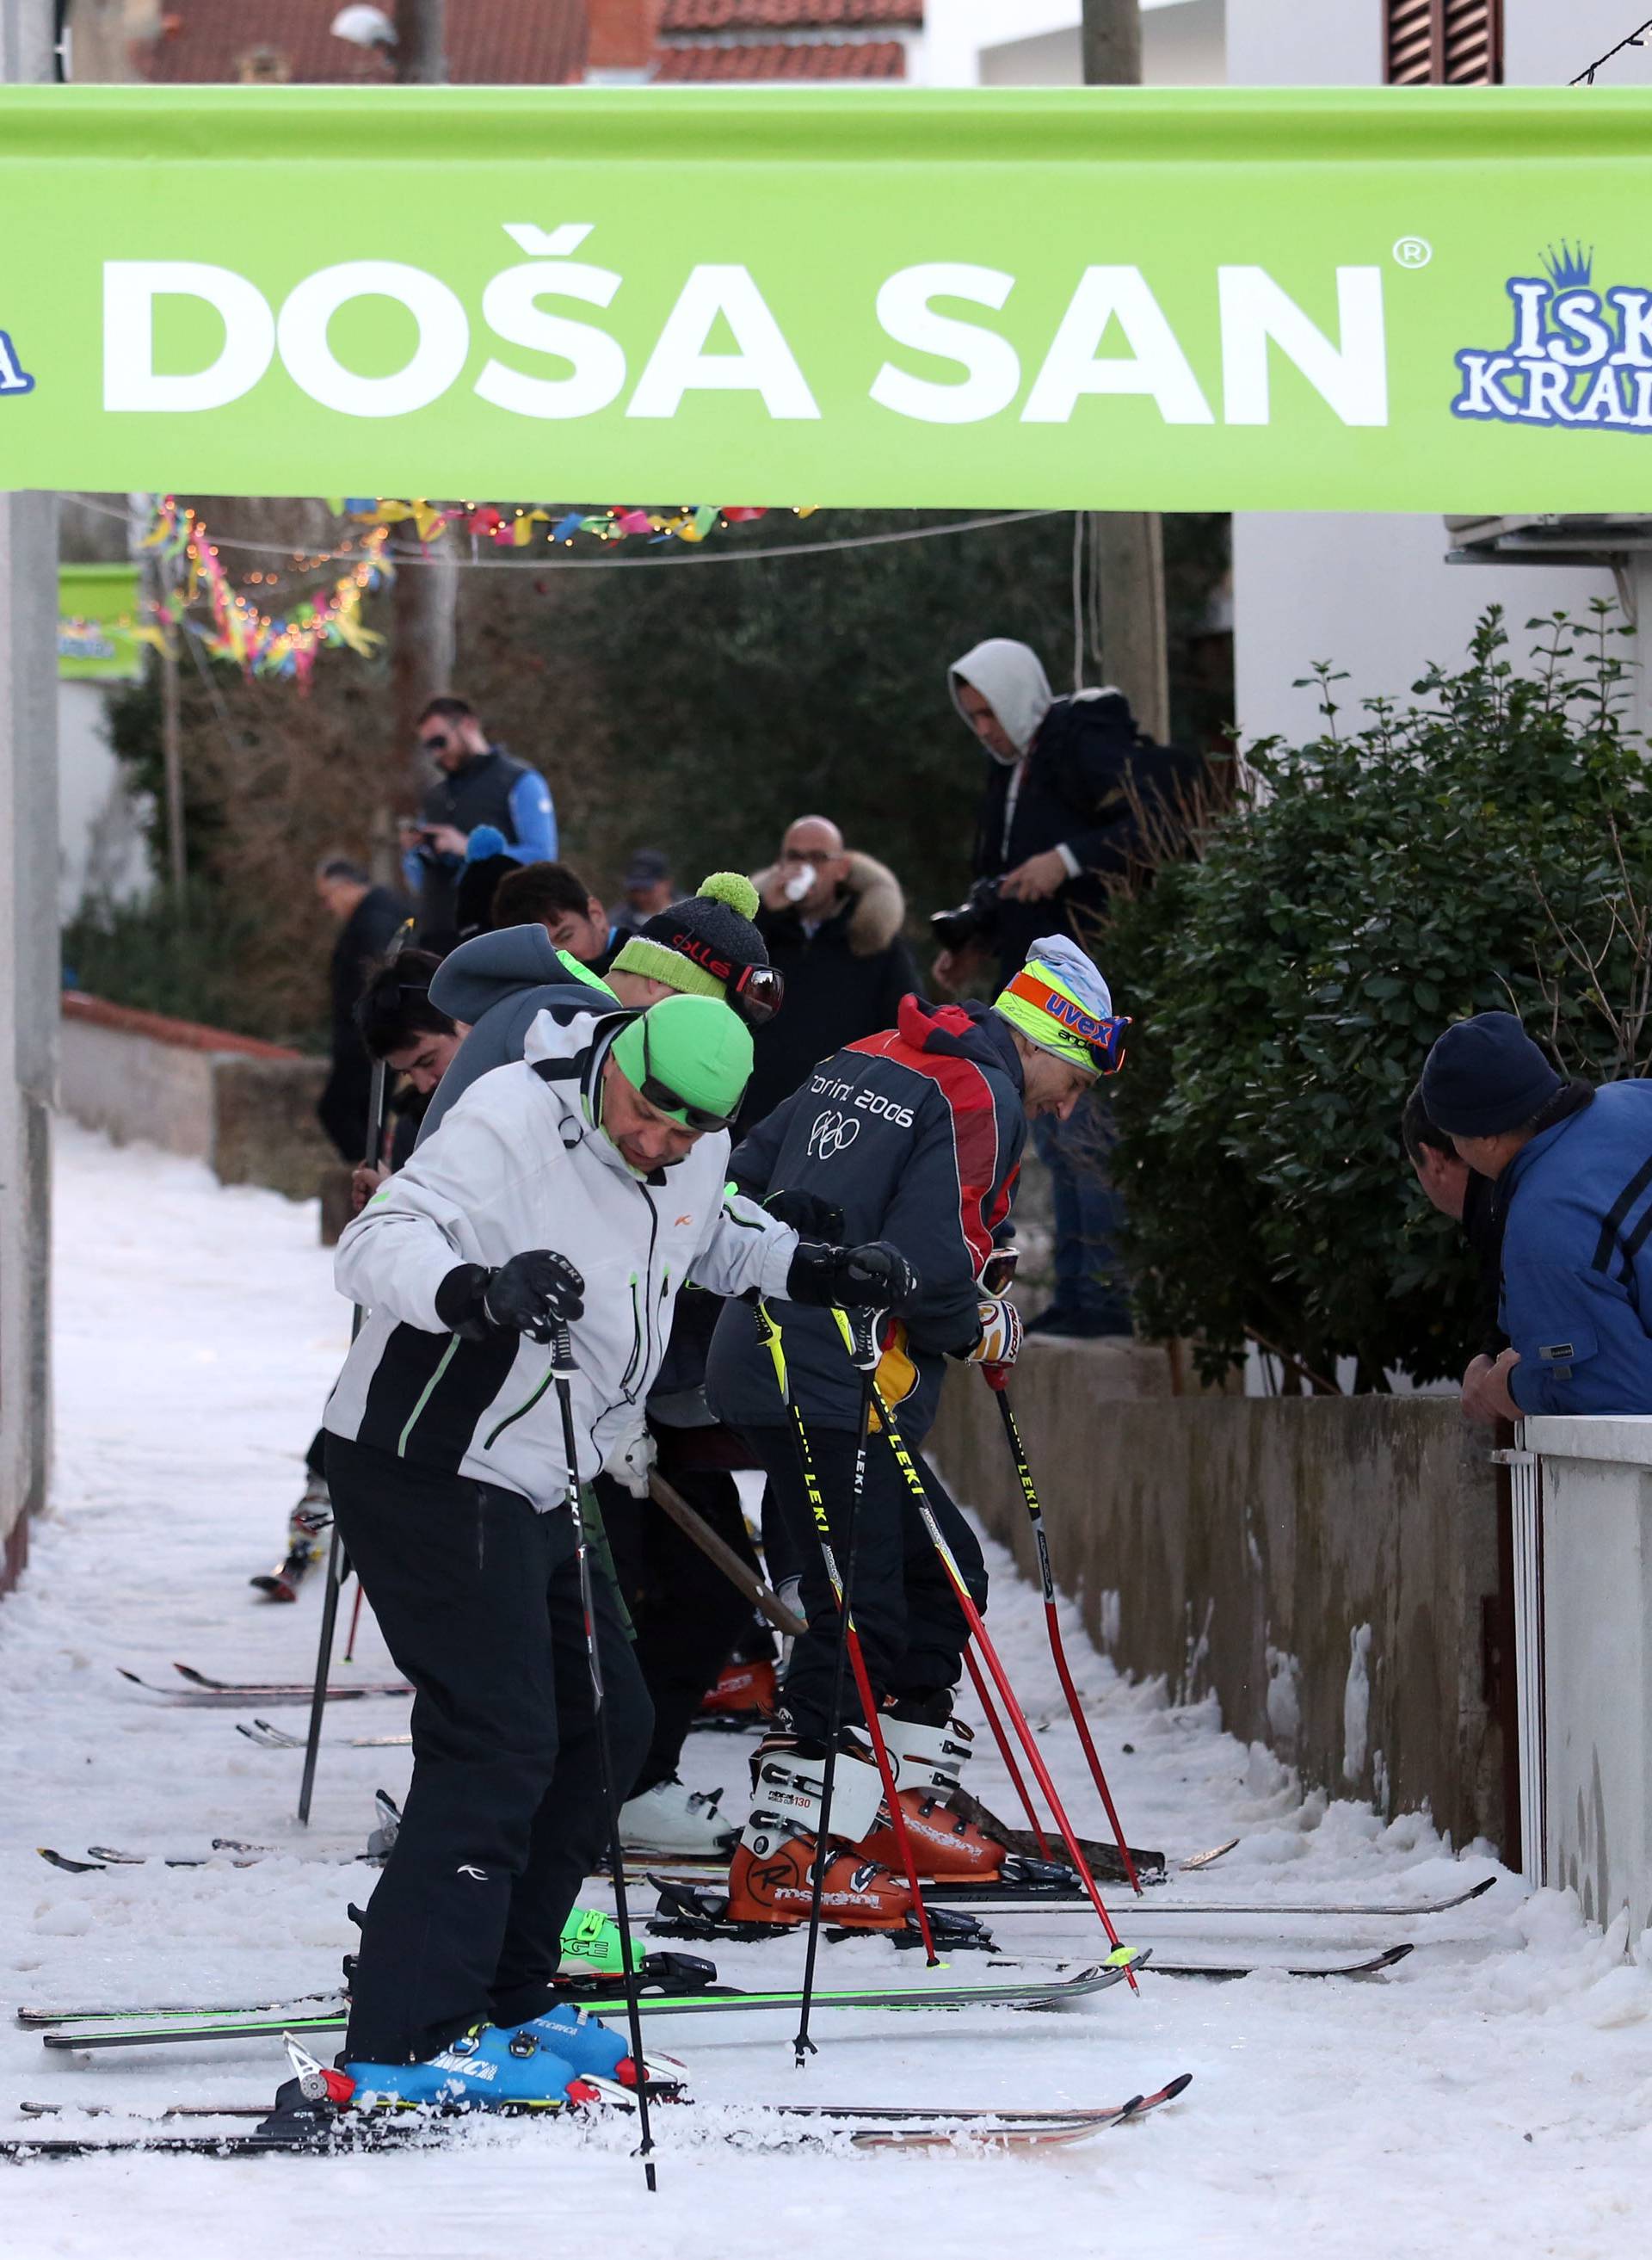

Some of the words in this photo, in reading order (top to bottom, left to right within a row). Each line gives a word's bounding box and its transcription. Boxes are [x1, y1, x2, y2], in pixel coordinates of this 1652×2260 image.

[103, 224, 822, 419] DOŠA
[1045, 993, 1113, 1047] uvex
[811, 1074, 854, 1102] orin
[854, 1089, 915, 1128] 2006
[854, 1448, 866, 1494] LEKI
[888, 1435, 925, 1494] LEKI
[1018, 1464, 1039, 1508] LEKI
[804, 1473, 829, 1532] LEKI
[794, 1796, 811, 1808] 130
[774, 1887, 883, 1910] rosignol
